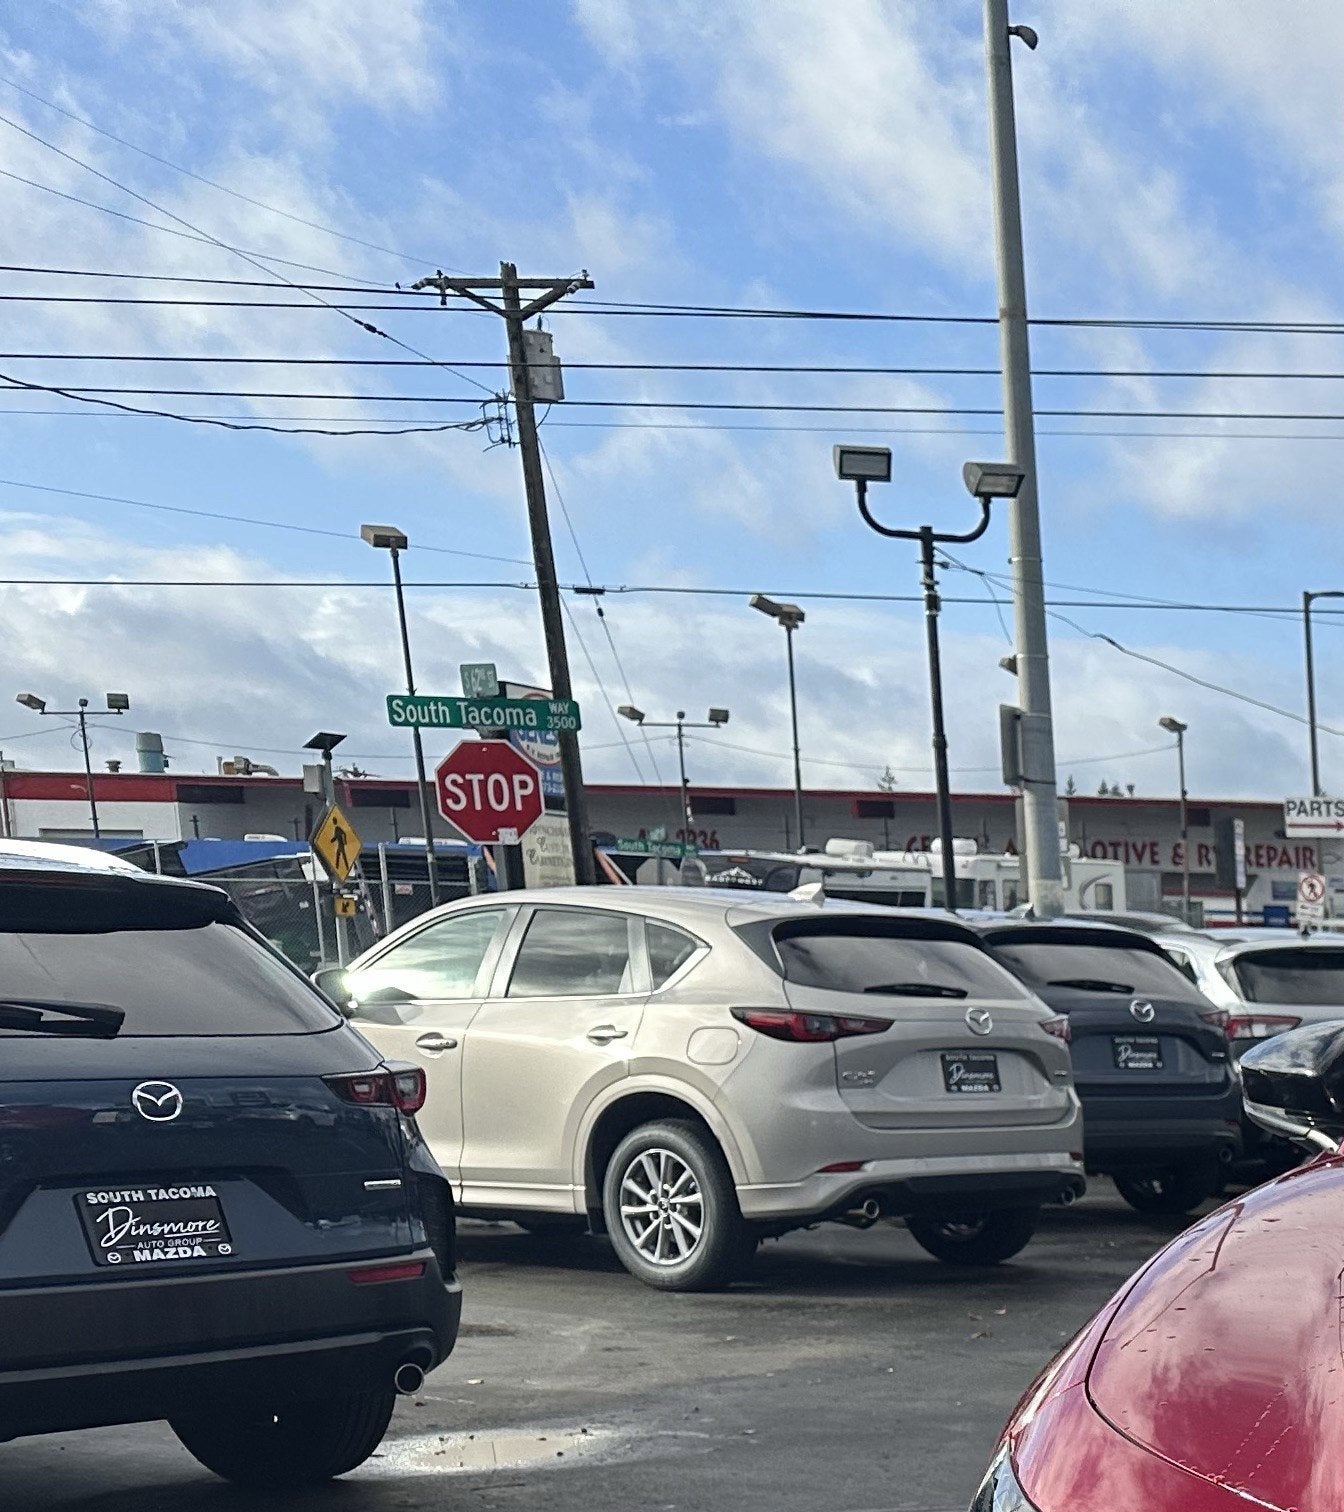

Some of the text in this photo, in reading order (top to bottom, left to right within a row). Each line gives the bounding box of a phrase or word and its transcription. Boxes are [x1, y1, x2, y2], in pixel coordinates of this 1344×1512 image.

[391, 698, 537, 726] South Tacoma
[549, 702, 570, 714] WAY
[546, 716, 577, 730] 3500
[444, 773, 535, 812] STOP
[86, 1186, 217, 1204] SOUTH TACOMA
[96, 1206, 220, 1247] Dinsmore
[137, 1238, 203, 1250] AUTO GROUP
[133, 1246, 206, 1262] MAZDA
